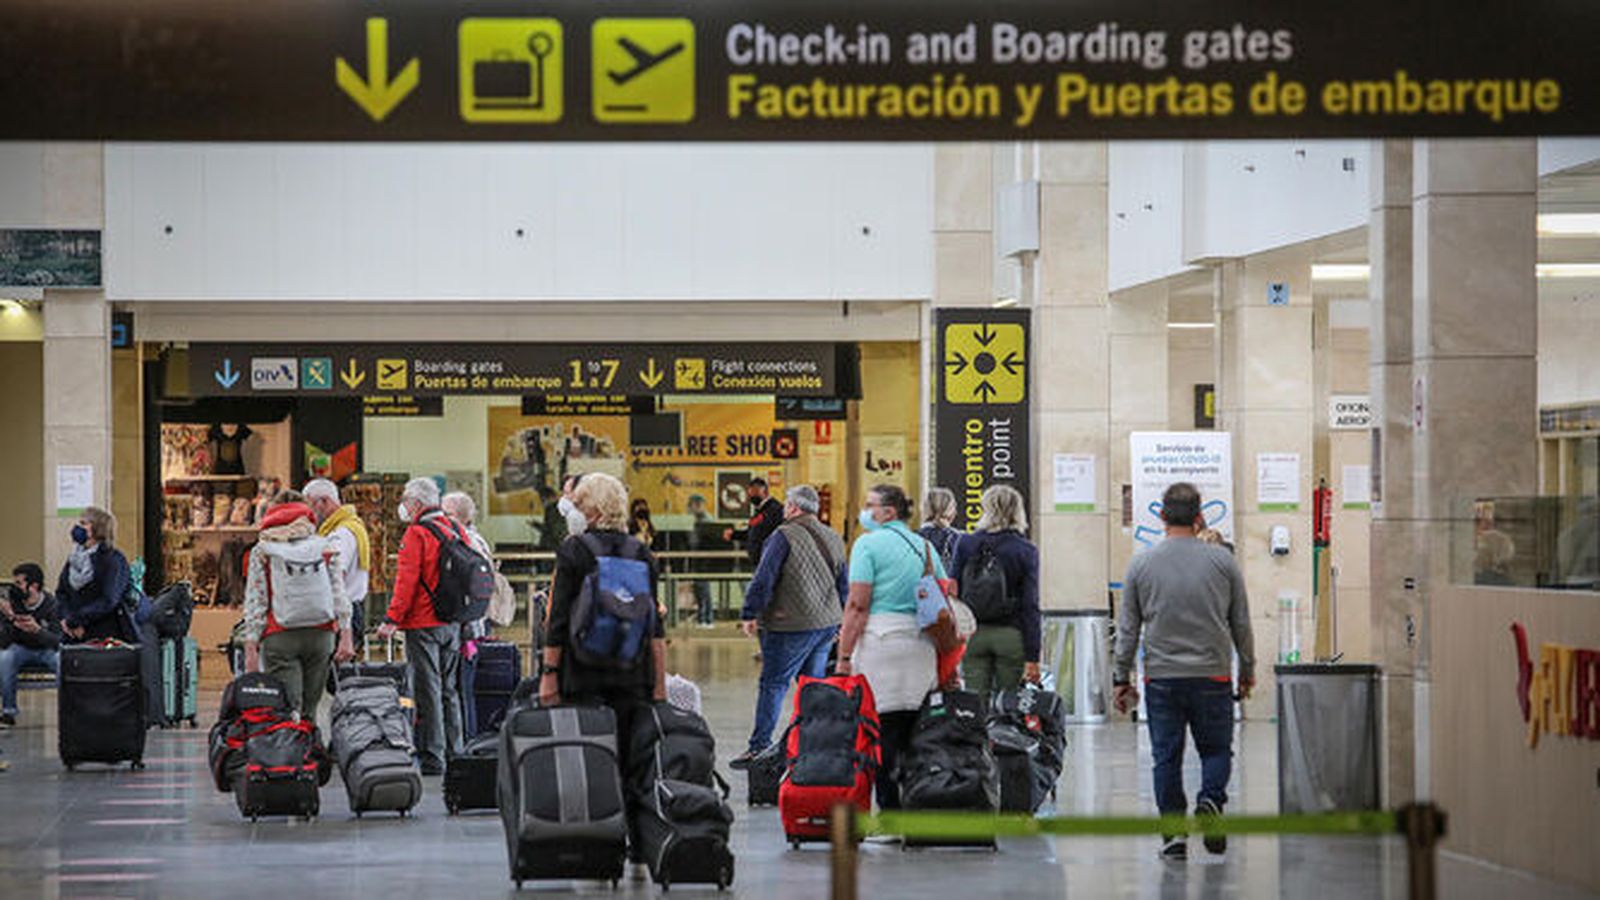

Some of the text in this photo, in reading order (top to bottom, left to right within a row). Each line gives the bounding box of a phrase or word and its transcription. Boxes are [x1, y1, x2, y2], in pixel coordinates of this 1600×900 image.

[726, 22, 1292, 68] Check-in and Boarding gates
[727, 70, 1560, 126] Facturación y Puertas de embarque
[414, 360, 503, 375] Boarding gates
[570, 360, 584, 388] 1
[601, 360, 620, 388] 7
[712, 360, 817, 374] Flight connections
[414, 375, 562, 390] Puertas de embarque
[713, 374, 822, 388] Conexión vuelos
[726, 434, 773, 456] SHO
[987, 417, 1015, 479] point
